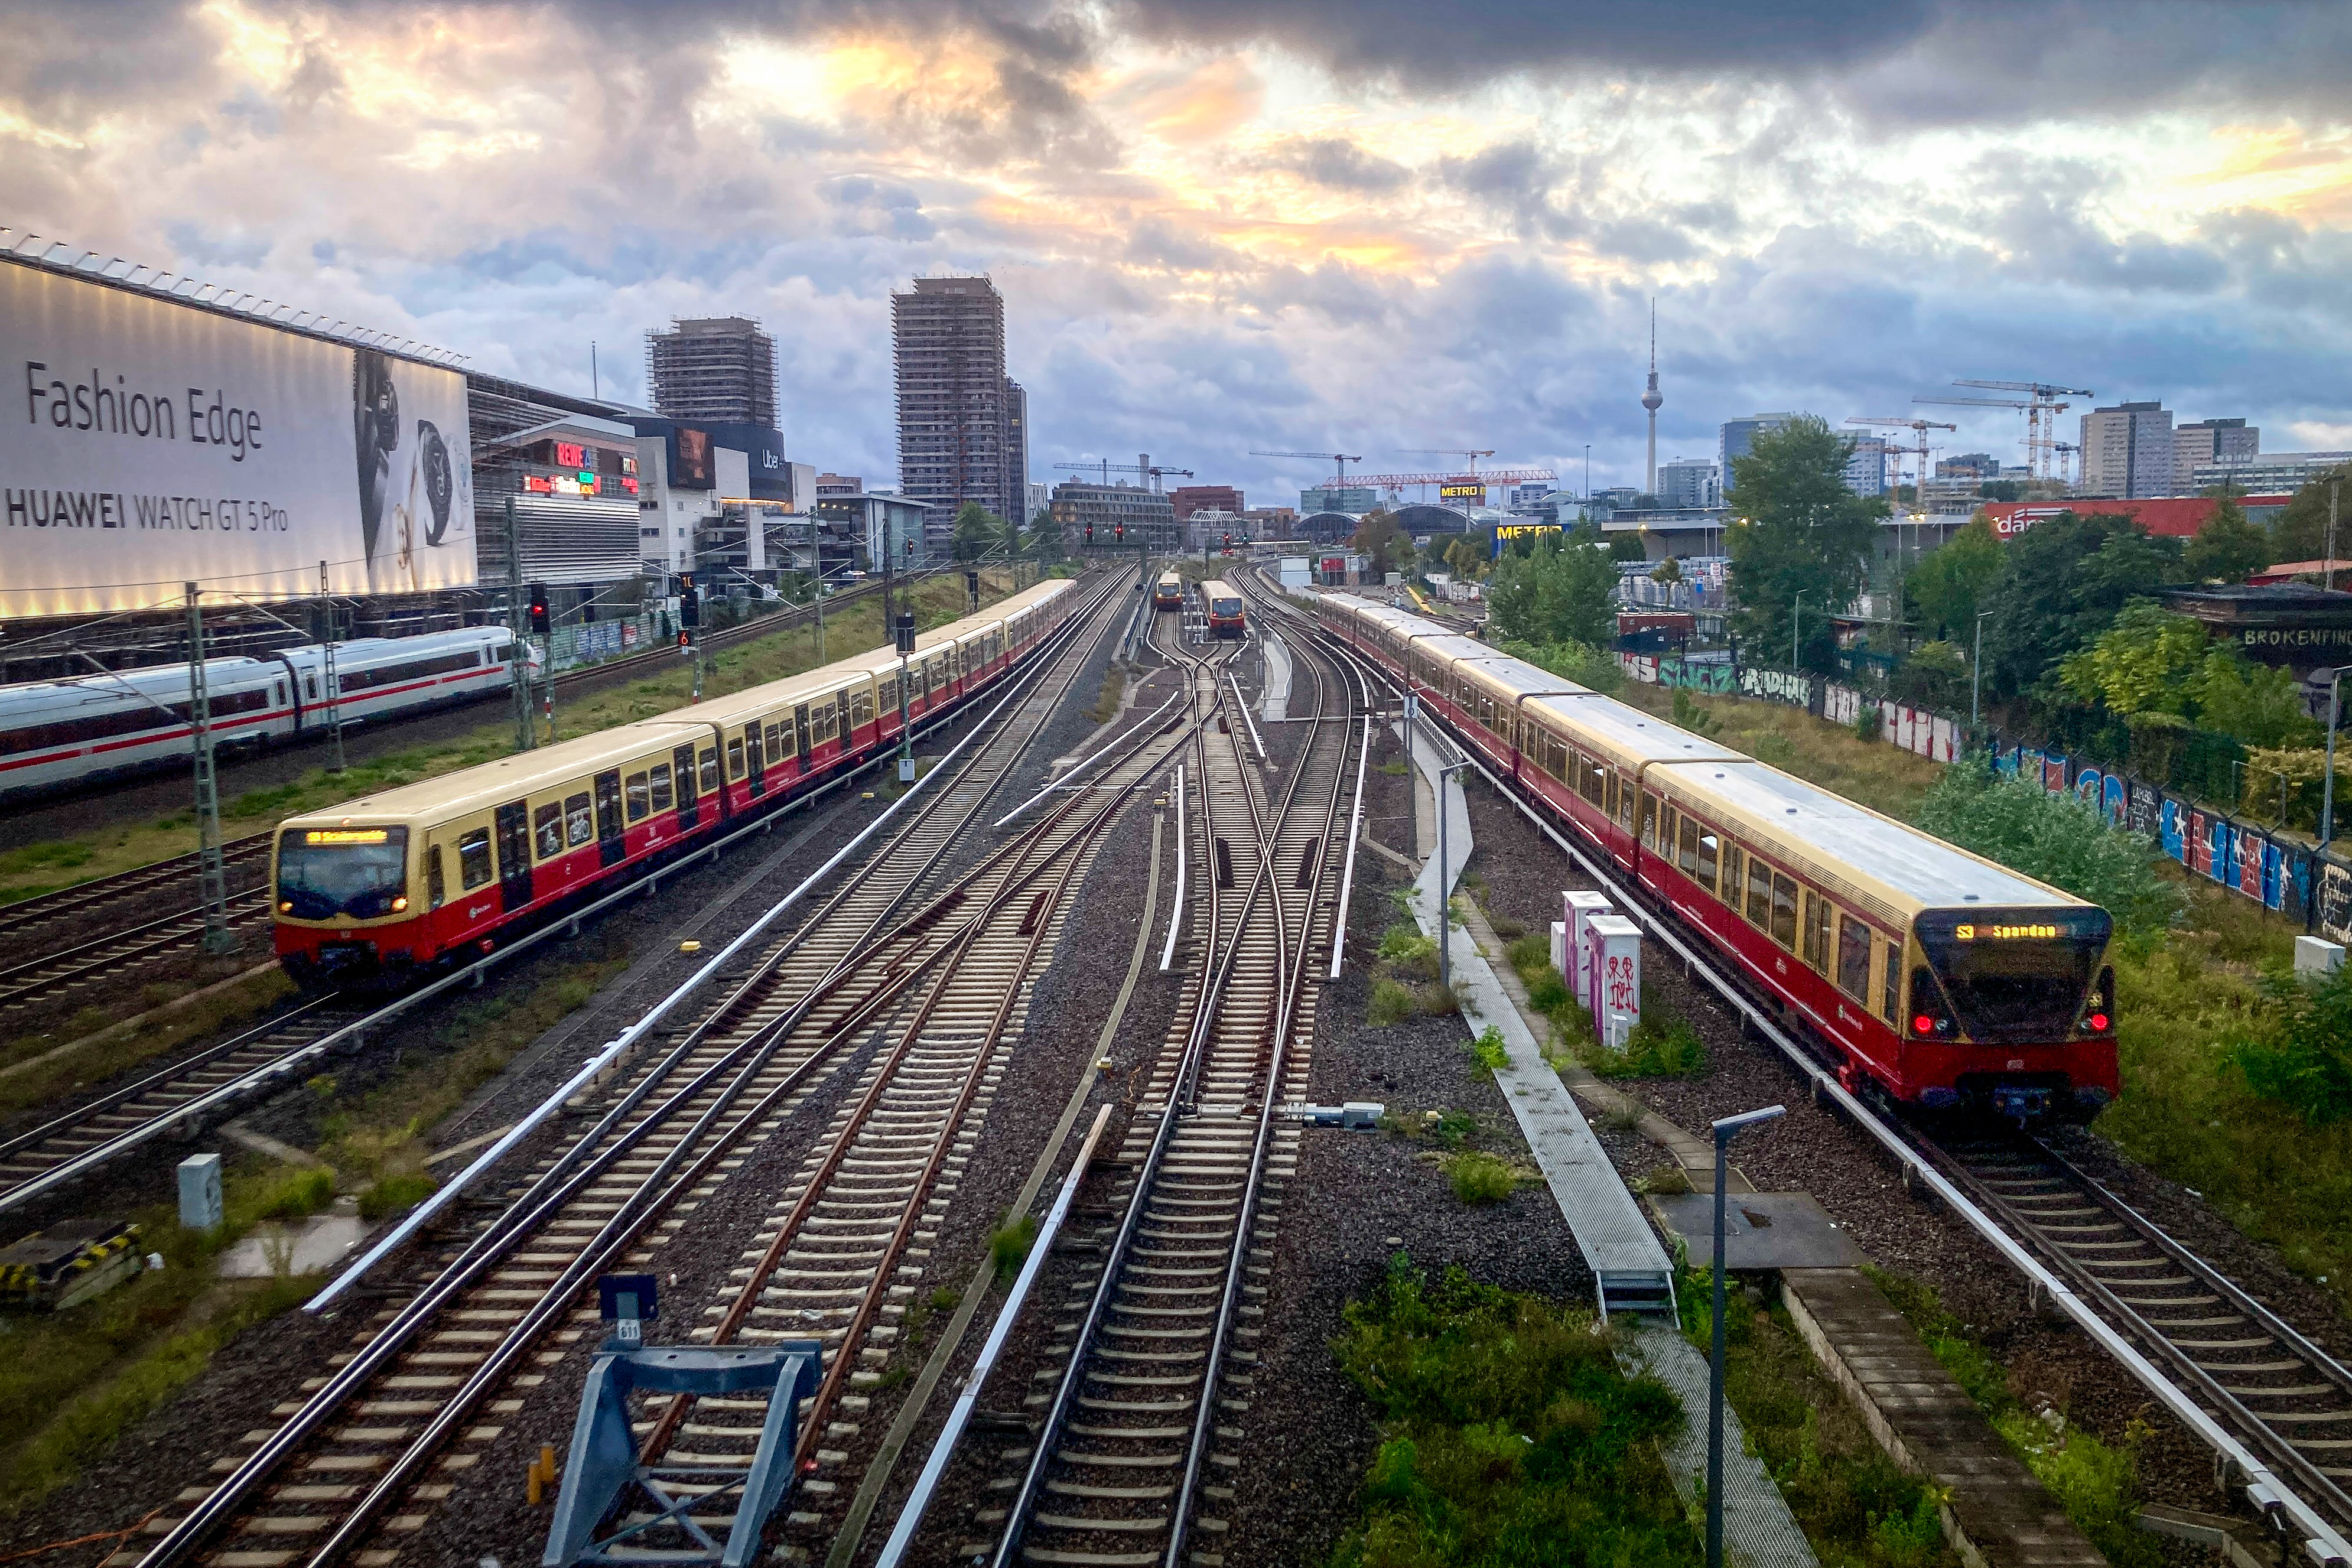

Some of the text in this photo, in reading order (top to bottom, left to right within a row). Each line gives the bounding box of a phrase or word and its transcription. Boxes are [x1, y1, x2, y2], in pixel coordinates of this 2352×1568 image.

[25, 360, 263, 463] Fashion Edge
[557, 443, 584, 468] REWE
[763, 449, 779, 469] Uber
[1442, 486, 1477, 496] METRO
[5, 488, 289, 531] HUAWEI WATCH GT 5 Pro
[681, 632, 688, 645] 6
[1957, 923, 2056, 939] S3 Spandau
